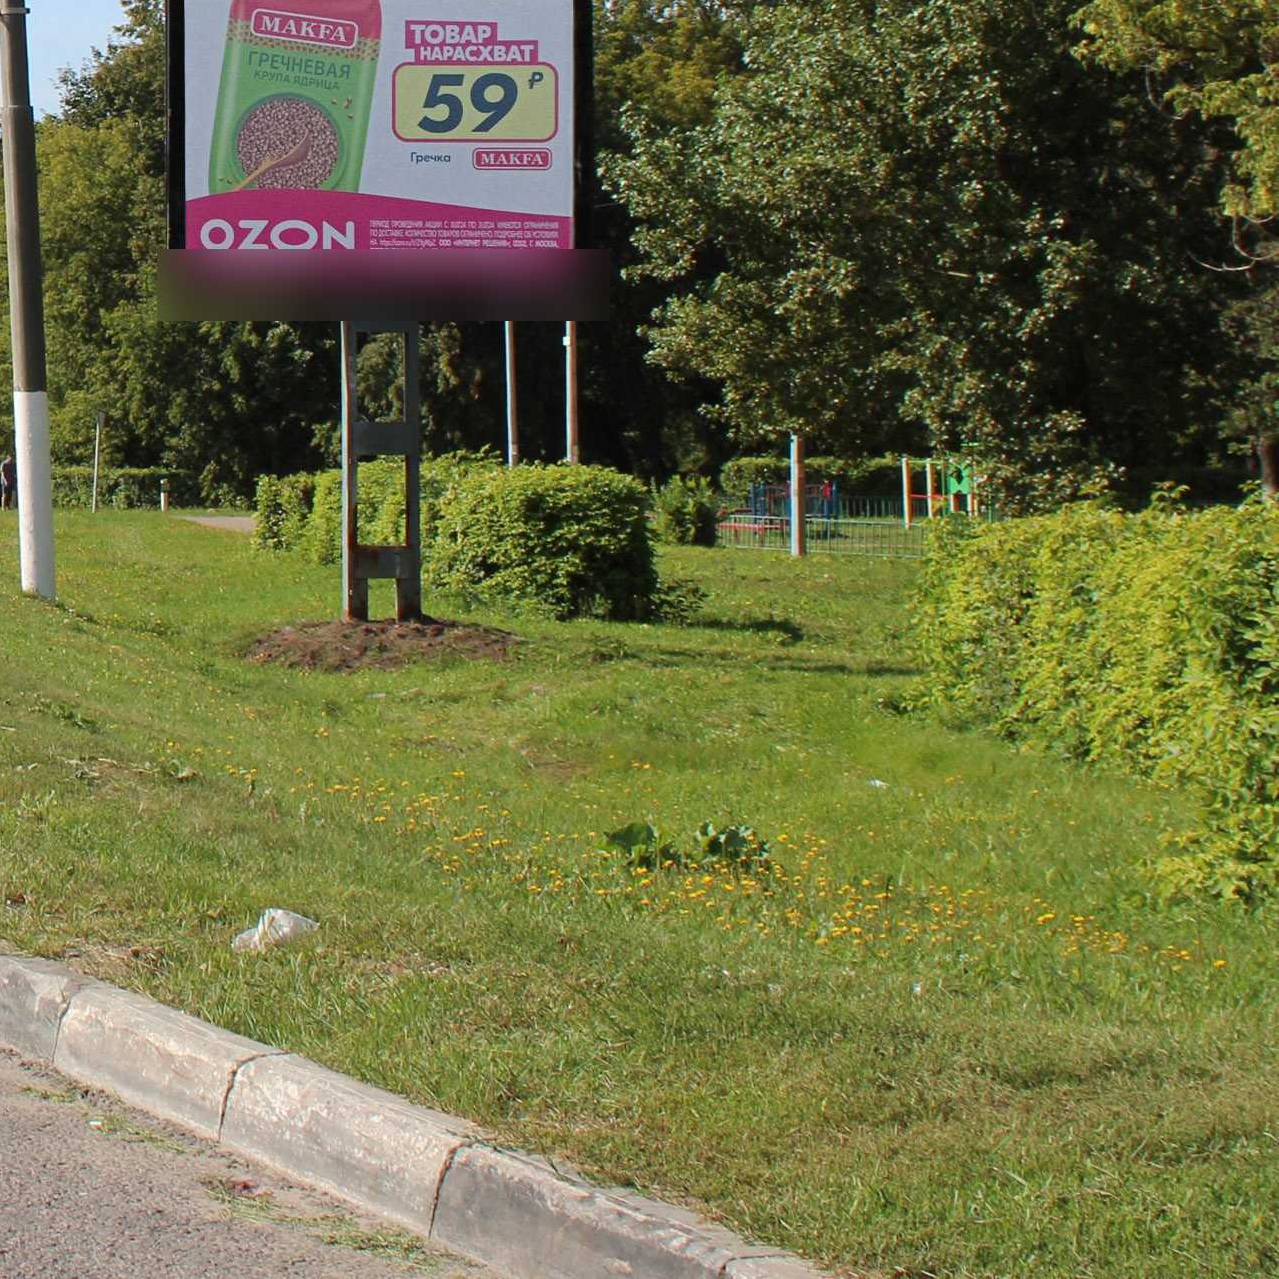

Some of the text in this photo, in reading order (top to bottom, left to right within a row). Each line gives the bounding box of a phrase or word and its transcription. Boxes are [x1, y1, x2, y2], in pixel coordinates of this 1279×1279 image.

[260, 15, 348, 43] MAKFA
[410, 24, 492, 44] ТОВАР
[248, 51, 351, 80] ГРЕЧНЕВАЯ
[420, 45, 535, 62] НАРАСХВАТ
[417, 72, 519, 134] 59
[410, 152, 452, 165] Гречка
[480, 153, 544, 165] MAKFA
[200, 219, 356, 249] OZON
